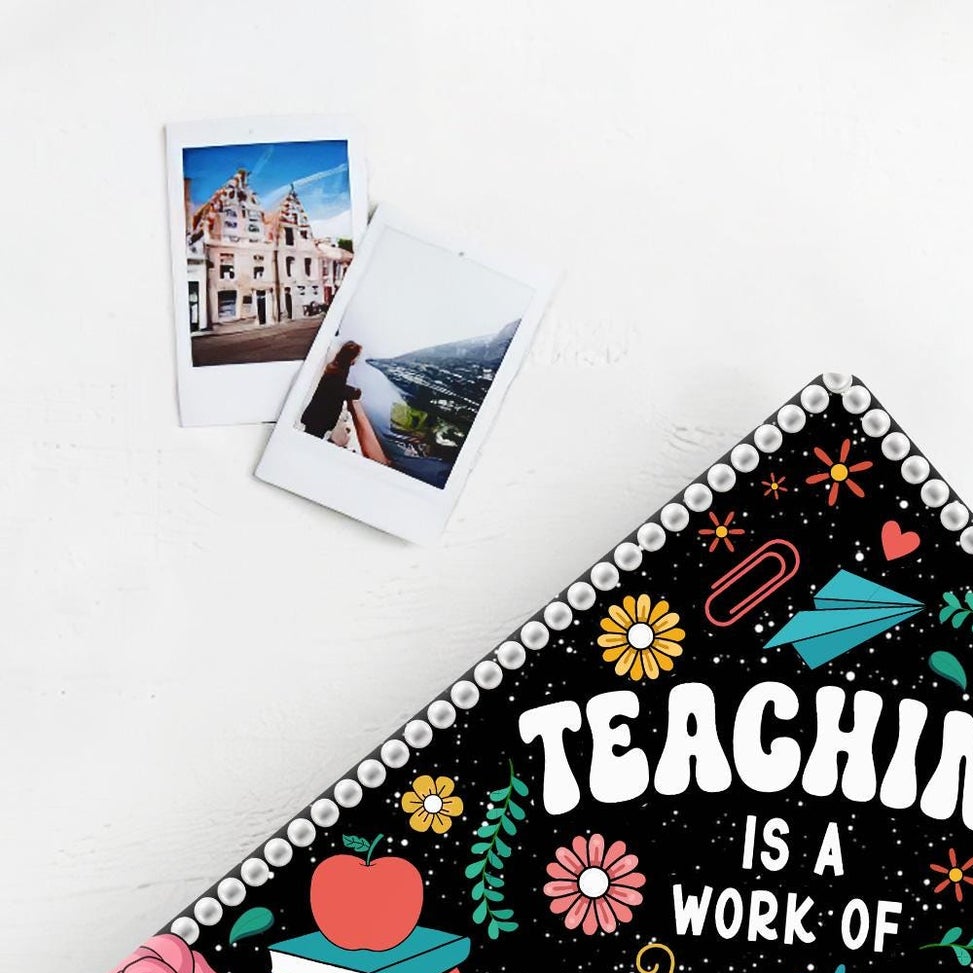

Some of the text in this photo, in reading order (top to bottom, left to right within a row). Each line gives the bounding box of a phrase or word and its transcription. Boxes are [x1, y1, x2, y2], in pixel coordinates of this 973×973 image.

[742, 814, 845, 877] IS A
[672, 883, 903, 953] WORK OF
